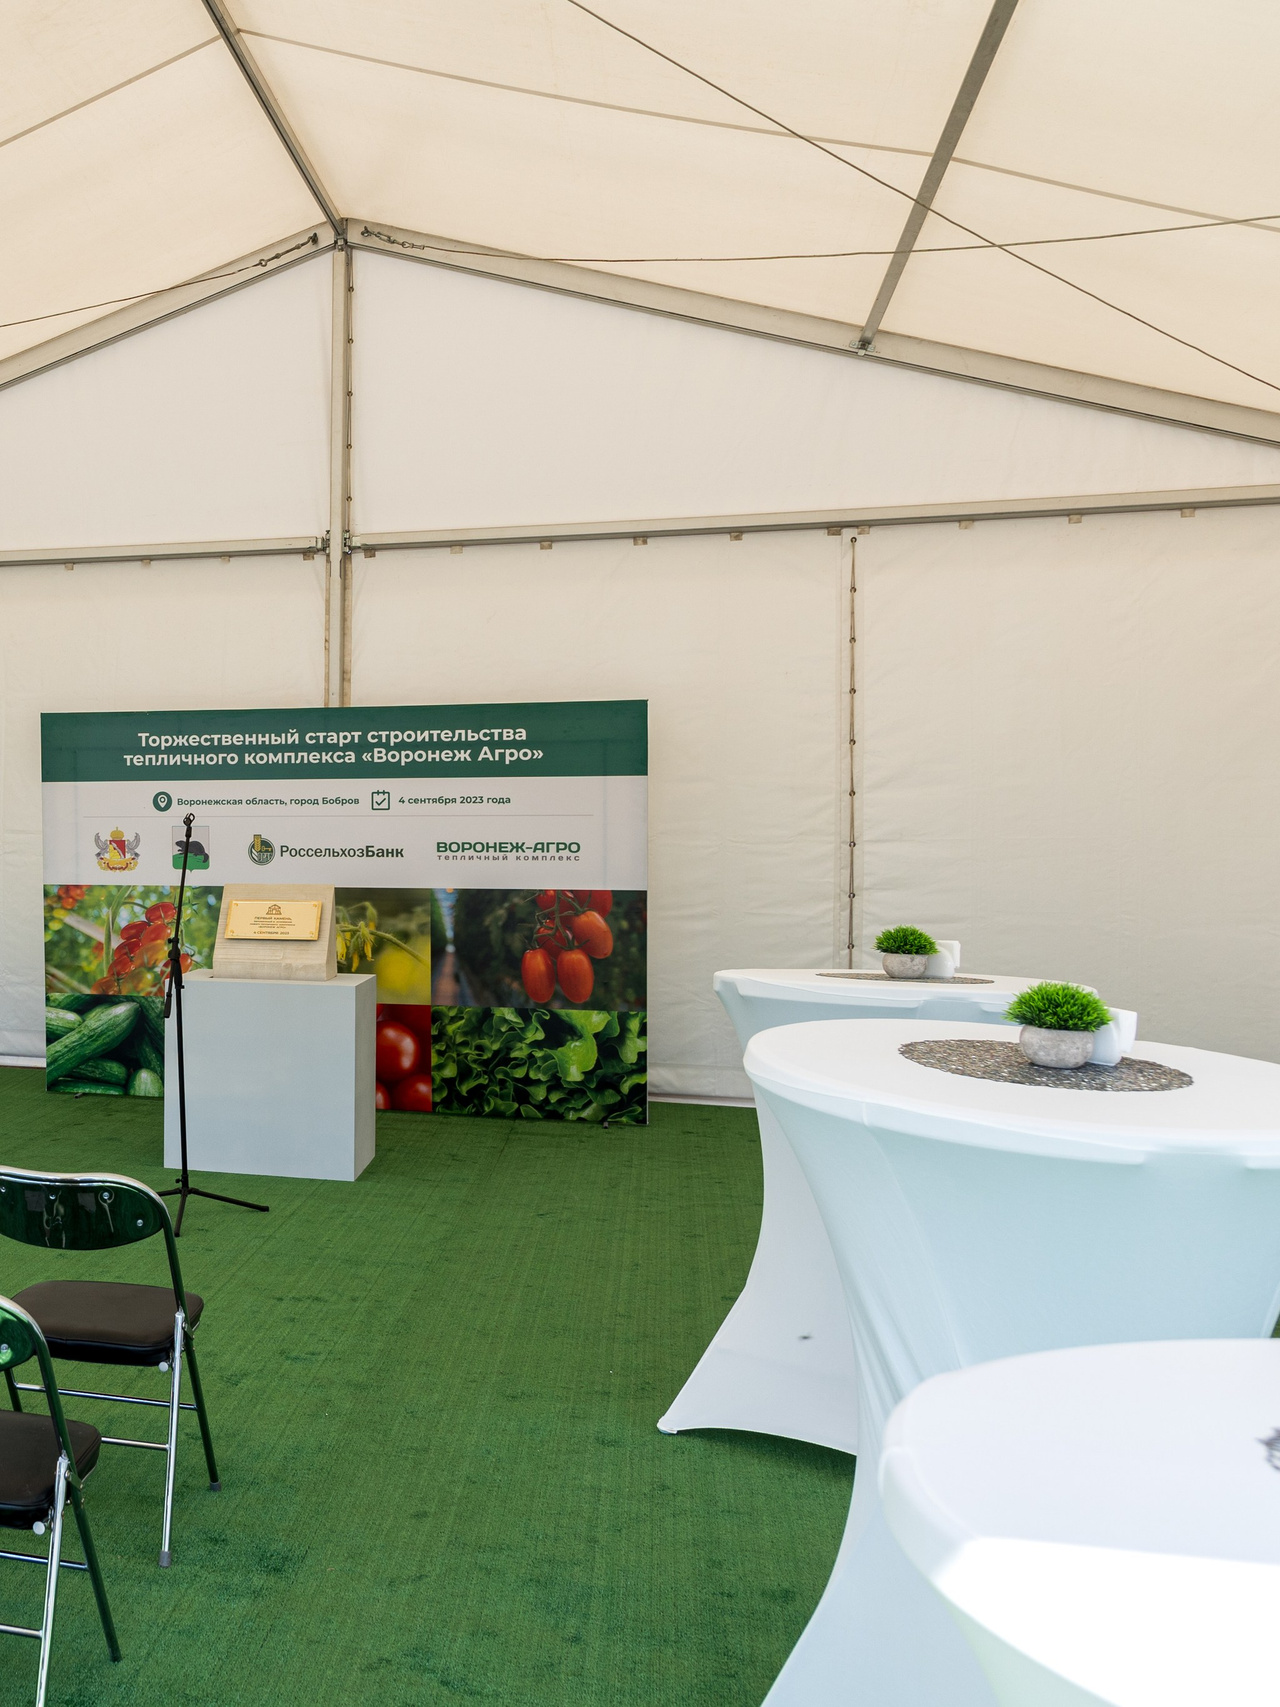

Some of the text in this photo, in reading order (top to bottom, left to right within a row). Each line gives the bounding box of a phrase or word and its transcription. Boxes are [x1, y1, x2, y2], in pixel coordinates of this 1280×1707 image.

[138, 727, 527, 749] Торжественный старт строительства
[123, 746, 544, 768] тепличного комплекса «Воронеж Агро»
[177, 796, 359, 808] Воронежская область, город Бобров
[398, 795, 511, 806] 4 сентября 2023 года
[280, 845, 404, 858] РоссельхозБанк
[437, 842, 580, 853] ВОРОНЕЖ-АГРО
